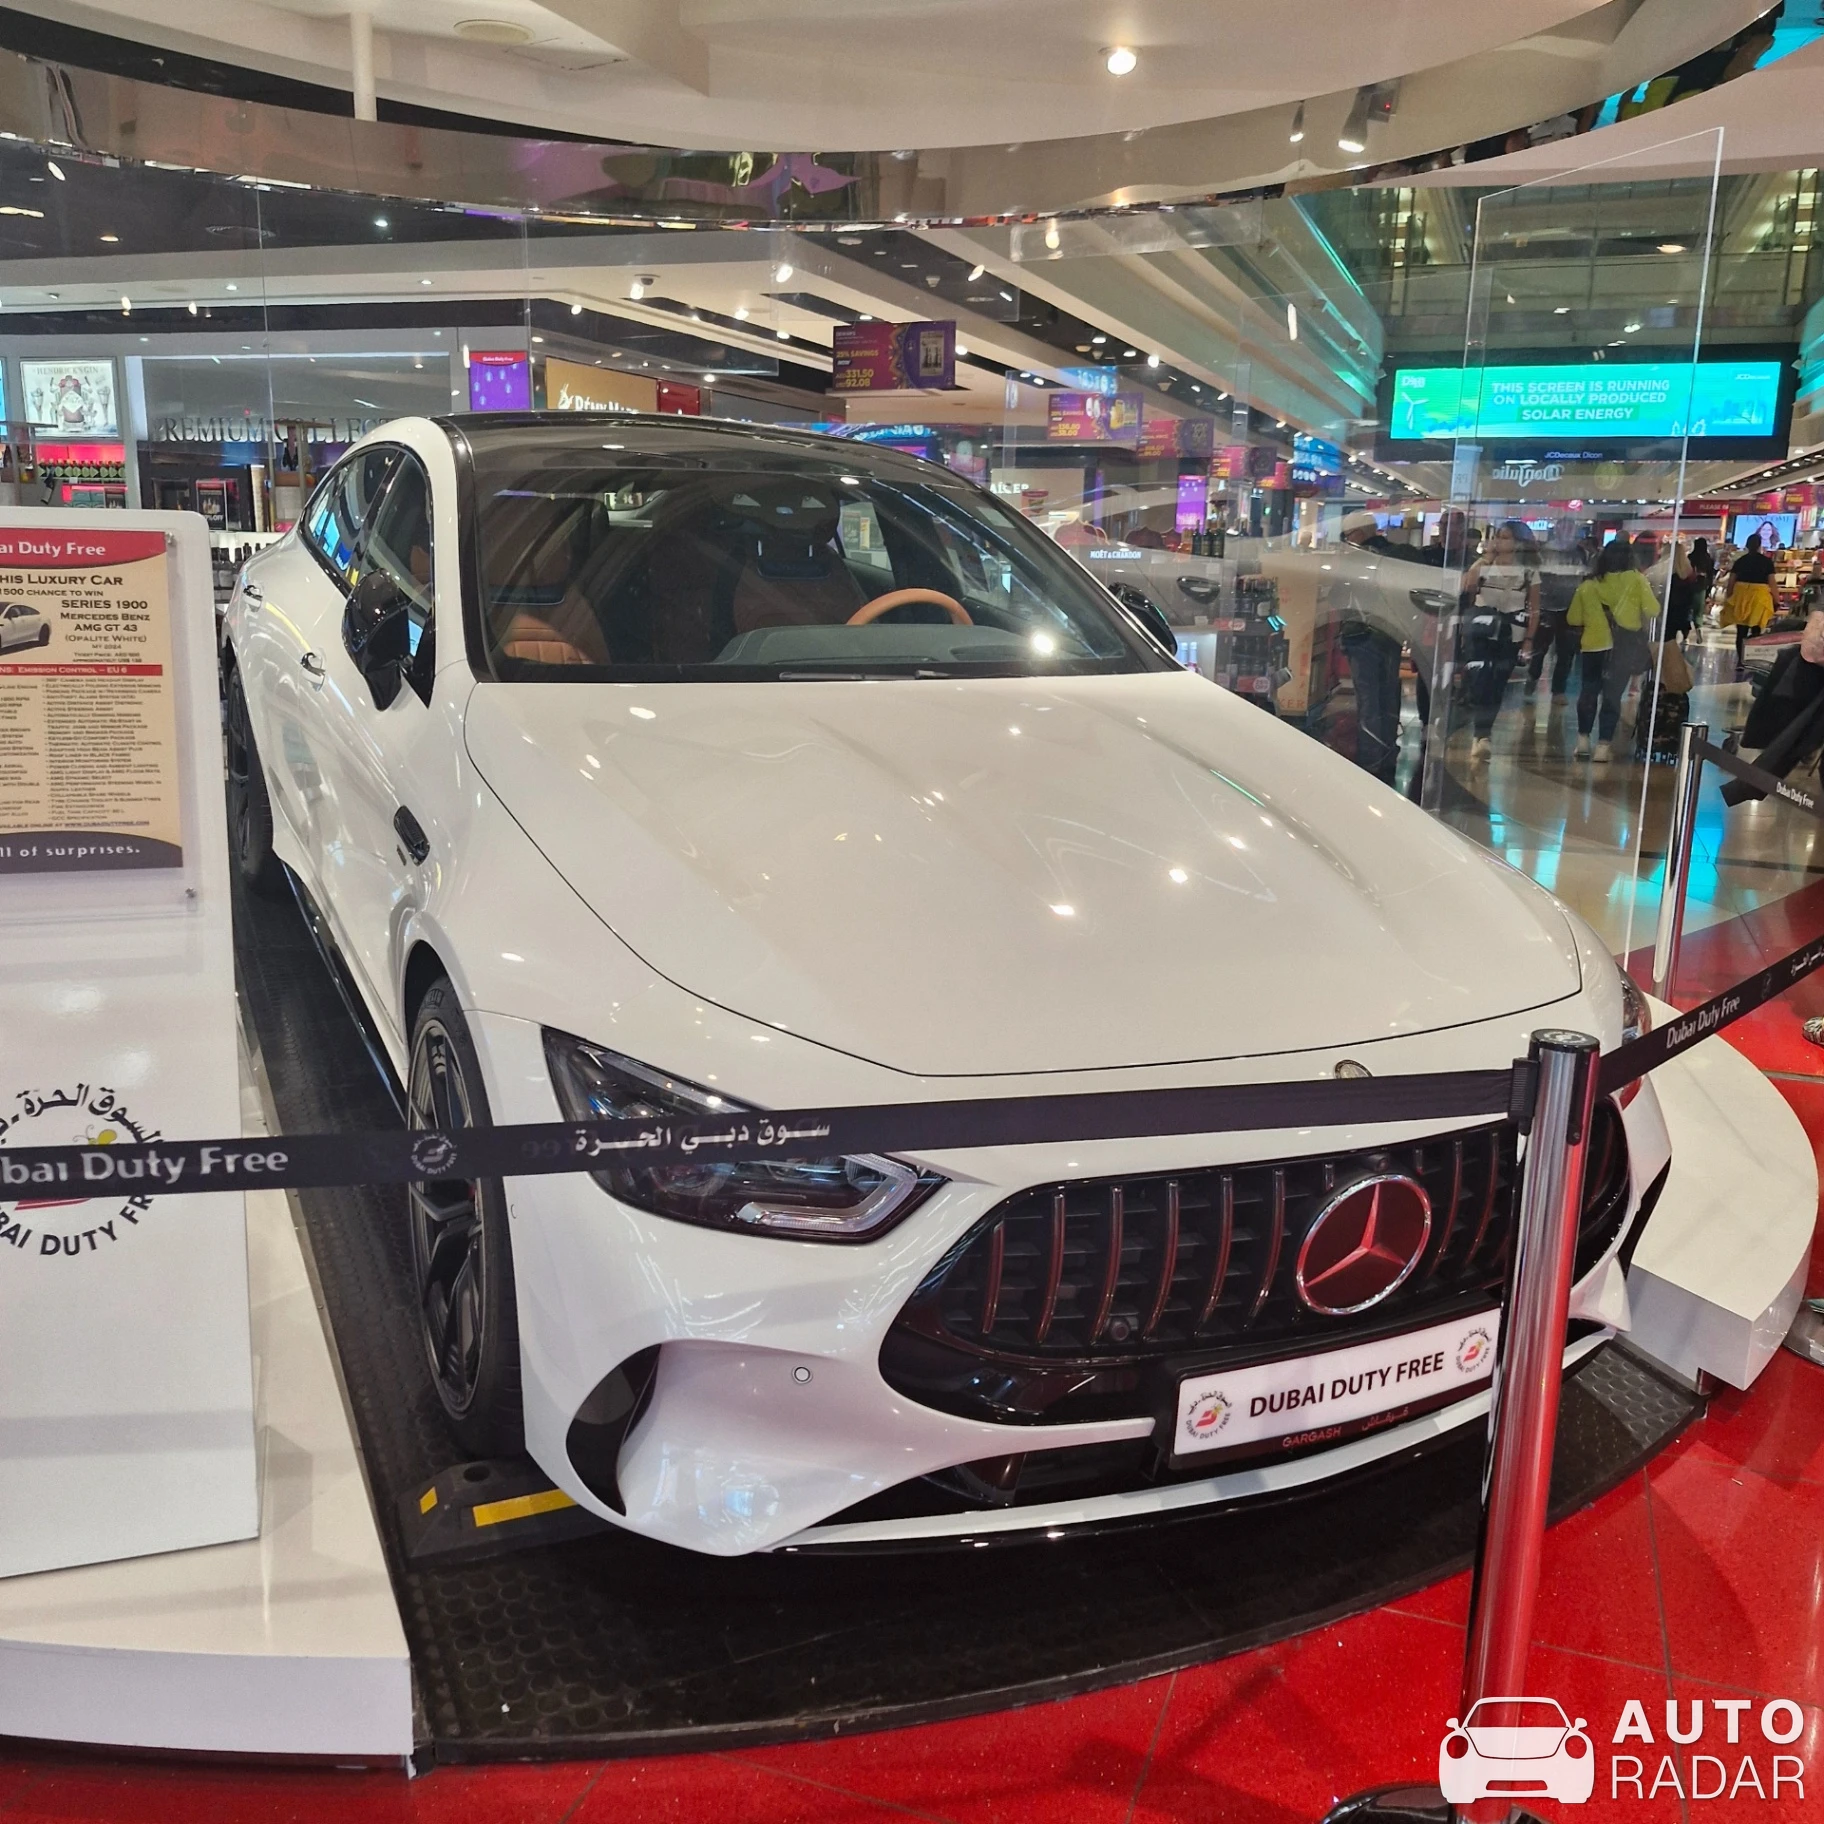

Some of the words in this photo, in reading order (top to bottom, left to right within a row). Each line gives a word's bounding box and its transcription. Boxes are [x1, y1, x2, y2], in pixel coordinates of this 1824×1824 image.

[1492, 382, 1524, 393] THIS
[1528, 382, 1585, 392] SCREEN
[1590, 381, 1602, 392] IS
[1607, 380, 1670, 392] RUNNING
[1493, 394, 1516, 405] ON
[1520, 394, 1584, 405] LOCALLY
[1588, 392, 1666, 404] PRODUCED
[1522, 409, 1570, 421] SOLAR
[1574, 408, 1634, 420] ENERGY
[1544, 451, 1581, 460] JCDecaux
[19, 542, 62, 557] Duty
[67, 542, 106, 556] Free
[1090, 550, 1108, 559] MOËT
[1113, 550, 1142, 559] CHANDON
[28, 574, 86, 585] LUXURY
[90, 576, 123, 586] CAR
[61, 600, 111, 609] SERIES
[117, 601, 148, 609] 1900
[20, 846, 37, 857] of
[46, 846, 140, 858] surprises.
[1666, 1023, 1696, 1049] Dubai
[1698, 1008, 1720, 1032] Duty
[1720, 996, 1740, 1018] Free
[680, 1118, 750, 1154] دبي
[757, 1118, 831, 1146] سوق
[574, 1128, 672, 1156] الحرة
[80, 1150, 186, 1184] Duty
[200, 1147, 288, 1175] Free
[40, 1220, 118, 1256] DUTY
[1250, 1382, 1325, 1418] DUBAI
[1330, 1366, 1392, 1400] DUTY
[1396, 1351, 1445, 1383] FREE
[1282, 1426, 1342, 1448] GARGASH
